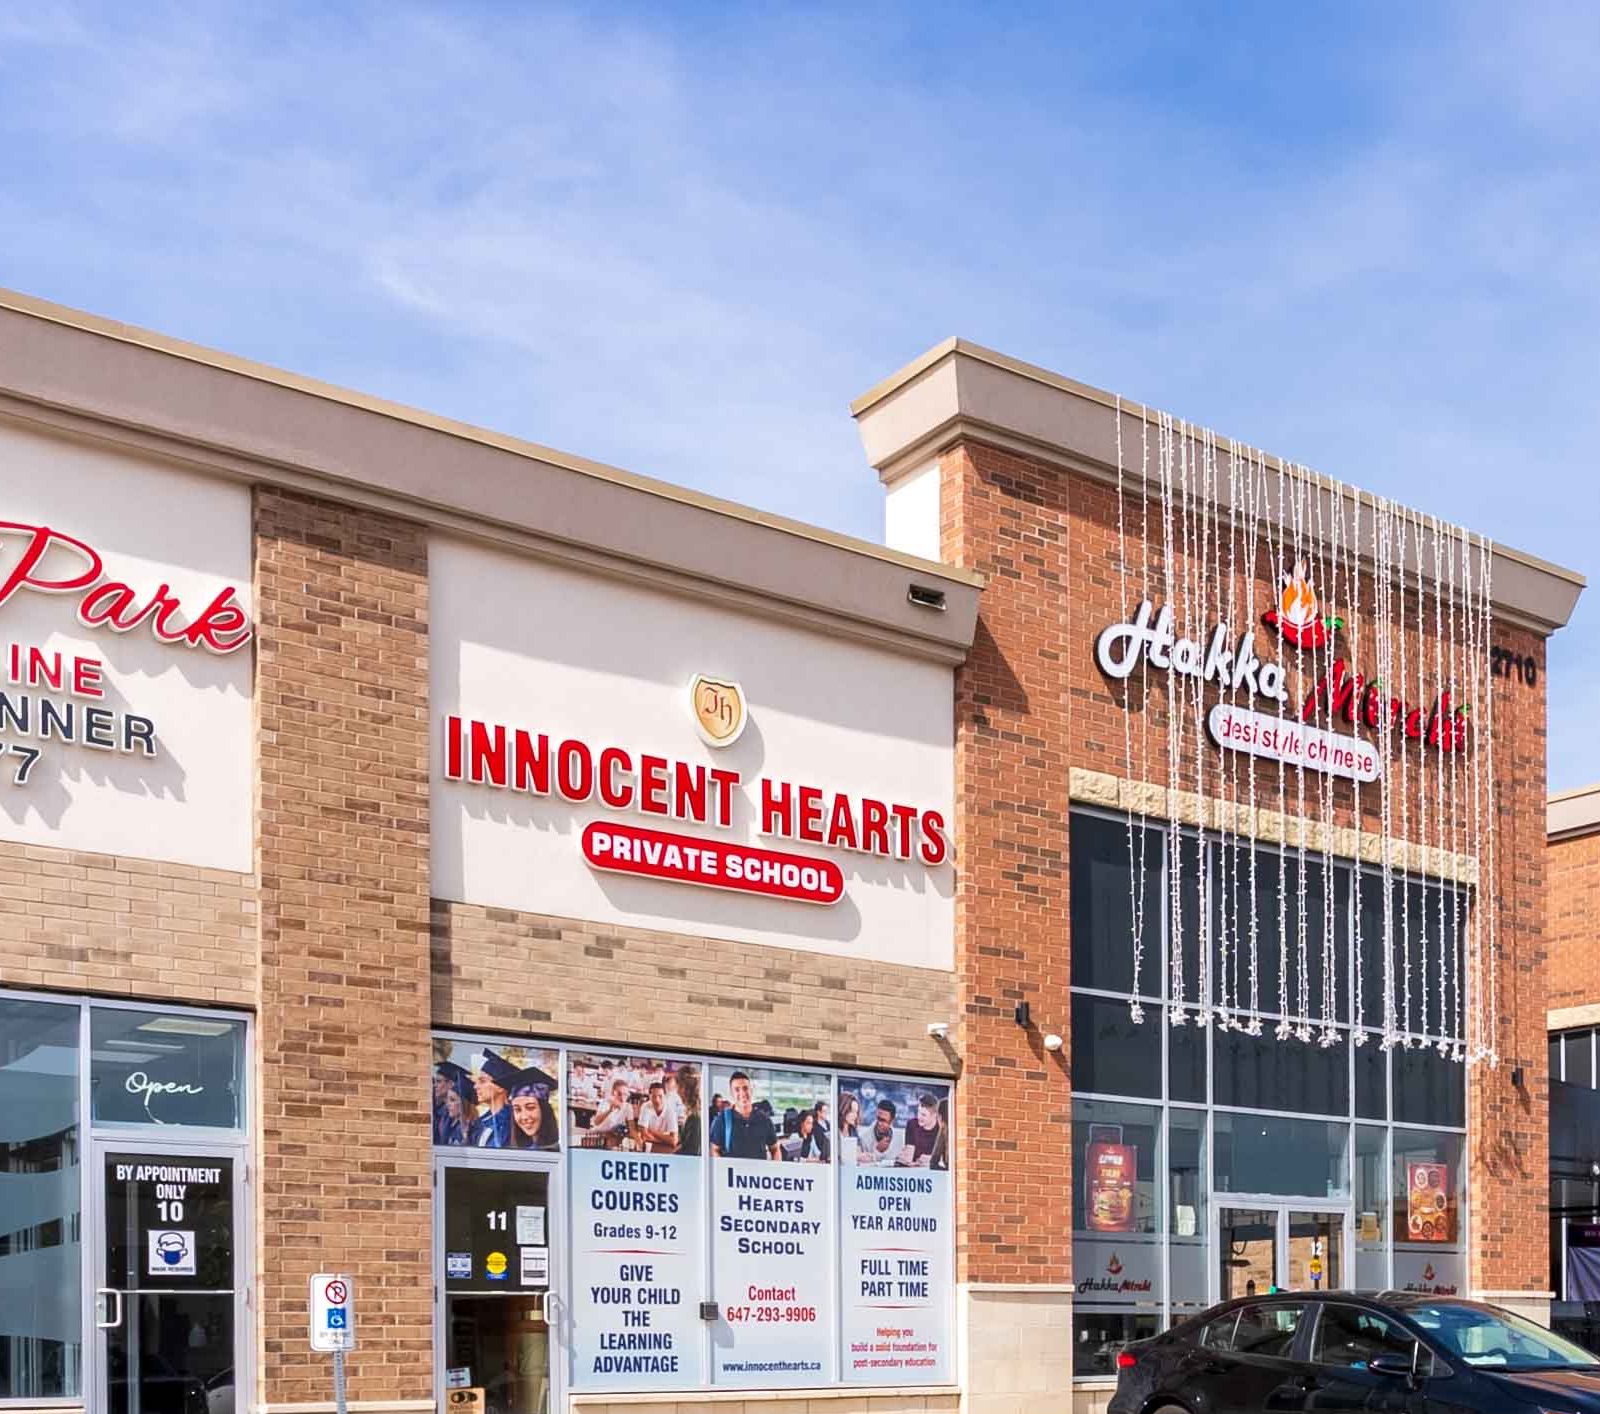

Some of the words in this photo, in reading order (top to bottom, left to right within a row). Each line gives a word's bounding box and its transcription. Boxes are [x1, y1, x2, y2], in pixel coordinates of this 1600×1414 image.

[0, 521, 251, 650] Park
[1098, 600, 1288, 701] Hakka
[1220, 714, 1258, 743] desi
[1308, 739, 1373, 772] chnese
[445, 715, 741, 828] INNOCENT
[761, 777, 946, 865] HEARTS
[591, 832, 717, 876] PRIVATE
[725, 854, 835, 894] SCHOOL
[126, 1072, 204, 1105] Open
[117, 1165, 134, 1180] BY
[136, 1165, 221, 1184] APPOINTMENT
[601, 1160, 669, 1183] CREDIT
[728, 1167, 814, 1192] INNOCENT
[156, 1184, 186, 1200] ONLY
[856, 1174, 933, 1193] ADMISSIONS
[591, 1190, 679, 1213] COURSES
[738, 1195, 804, 1214] HEARTS
[878, 1196, 911, 1212] OPEN
[157, 1201, 183, 1222] 10
[487, 1210, 507, 1230] 11
[593, 1223, 641, 1240] Grades
[646, 1224, 677, 1240] 9-12
[720, 1216, 821, 1236] SECONDARY
[851, 1215, 883, 1232] YEAR
[887, 1216, 937, 1233] AROUND
[738, 1237, 805, 1256] SCHOOL
[1311, 1241, 1323, 1256] 12
[620, 1264, 653, 1283] GIVE
[861, 1259, 891, 1276] FULL
[898, 1259, 929, 1276] TIME
[591, 1286, 634, 1305] YOUR
[637, 1287, 681, 1306] CHILD
[748, 1286, 796, 1301] Contact
[861, 1280, 892, 1298] PART
[898, 1281, 929, 1298] TIME
[623, 1310, 651, 1328] THE
[727, 1306, 816, 1323] 647-293-9906
[600, 1332, 672, 1351] LEARNING
[876, 1327, 901, 1339] Helping
[902, 1329, 914, 1339] you
[851, 1342, 869, 1353] build
[892, 1341, 927, 1353] foundation
[593, 1355, 679, 1374] ADVANTAGE
[722, 1359, 821, 1374] www.innocenthearts.ca
[905, 1357, 936, 1368] education
